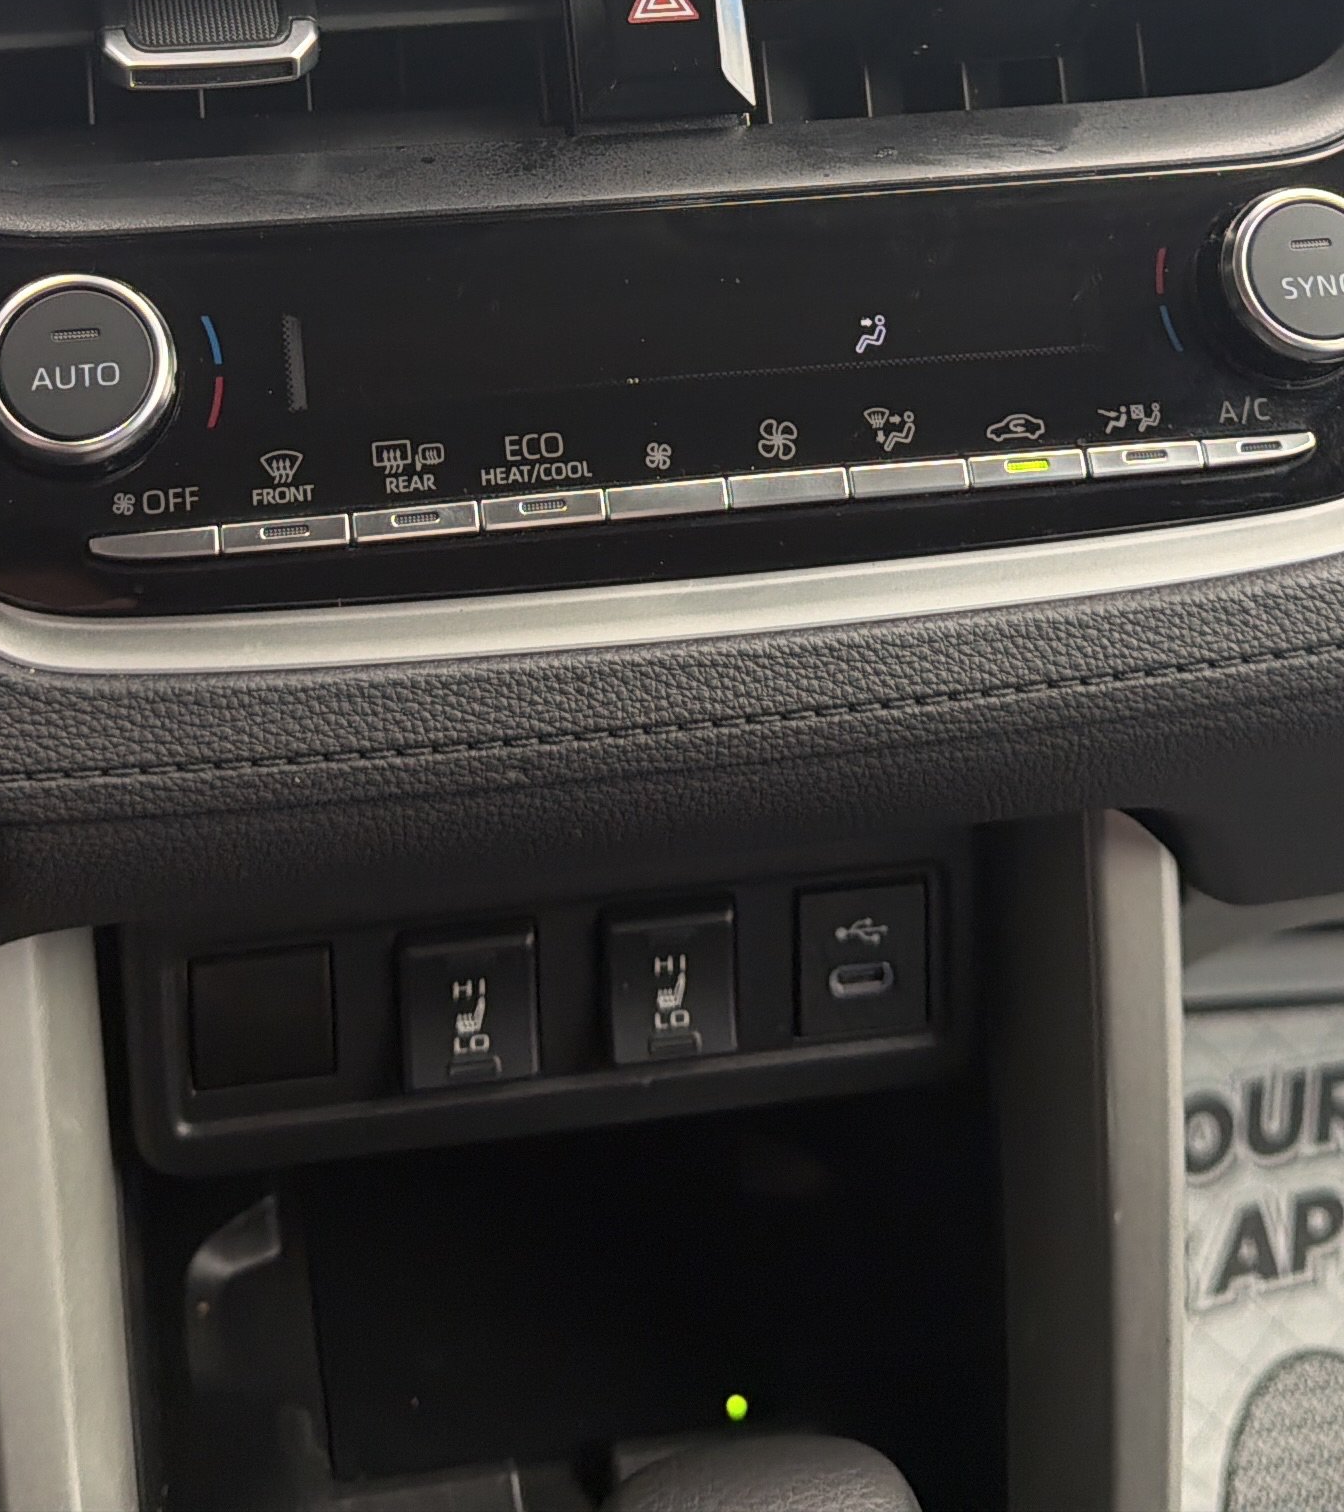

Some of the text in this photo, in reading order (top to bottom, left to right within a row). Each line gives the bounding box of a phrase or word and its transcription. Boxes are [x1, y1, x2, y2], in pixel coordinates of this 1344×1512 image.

[30, 362, 121, 392] AUTO
[1218, 395, 1273, 425] A/C
[504, 432, 565, 462] ECO
[385, 473, 437, 494] REAR
[480, 460, 594, 487] HEAT/COOL
[141, 486, 201, 515] OFF
[252, 484, 315, 507] FRONT
[653, 953, 687, 977] HI
[452, 976, 487, 1001] HI
[654, 1009, 691, 1030] LO
[454, 1033, 491, 1055] LO
